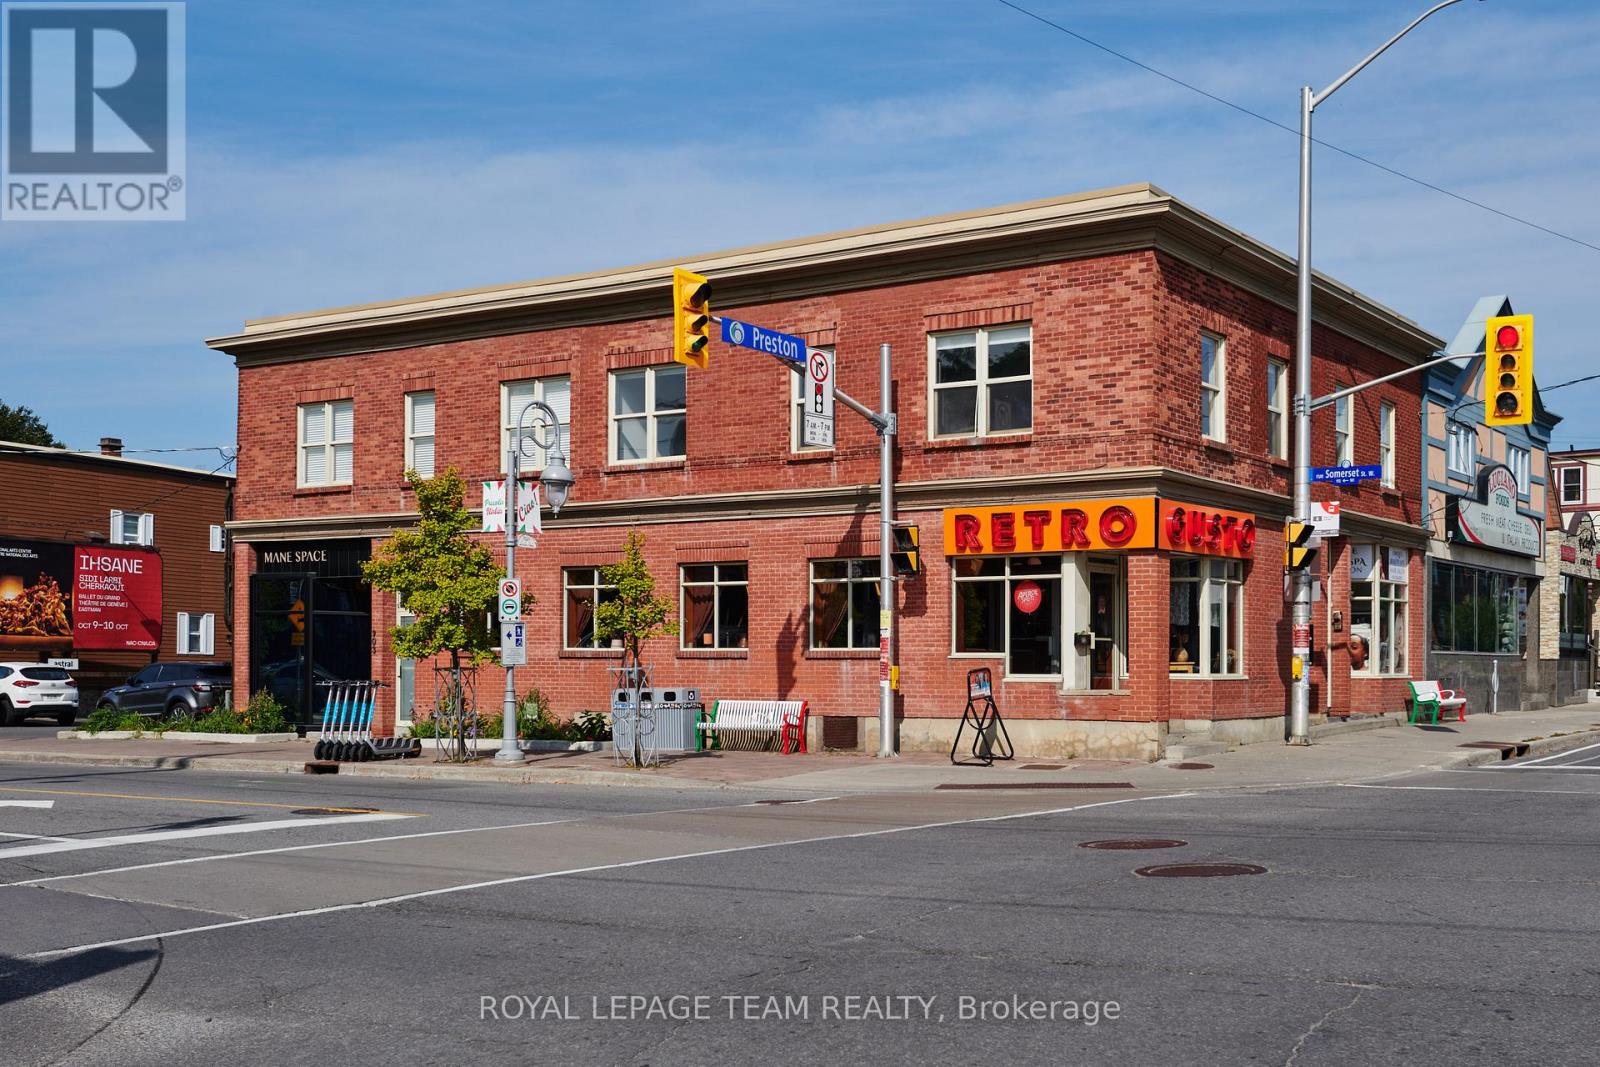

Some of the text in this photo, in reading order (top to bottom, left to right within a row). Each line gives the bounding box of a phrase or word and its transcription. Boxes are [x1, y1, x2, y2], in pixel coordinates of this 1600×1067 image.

[752, 327, 798, 358] Preston
[1325, 468, 1359, 479] Somerset
[1495, 493, 1510, 508] FOODS
[954, 505, 1255, 554] RETRO GUSTO
[264, 550, 327, 563] MANE SPACE
[80, 555, 143, 574] IHSANE
[79, 575, 122, 584] SIDI LARBI
[79, 582, 125, 592] CHERKAOUI
